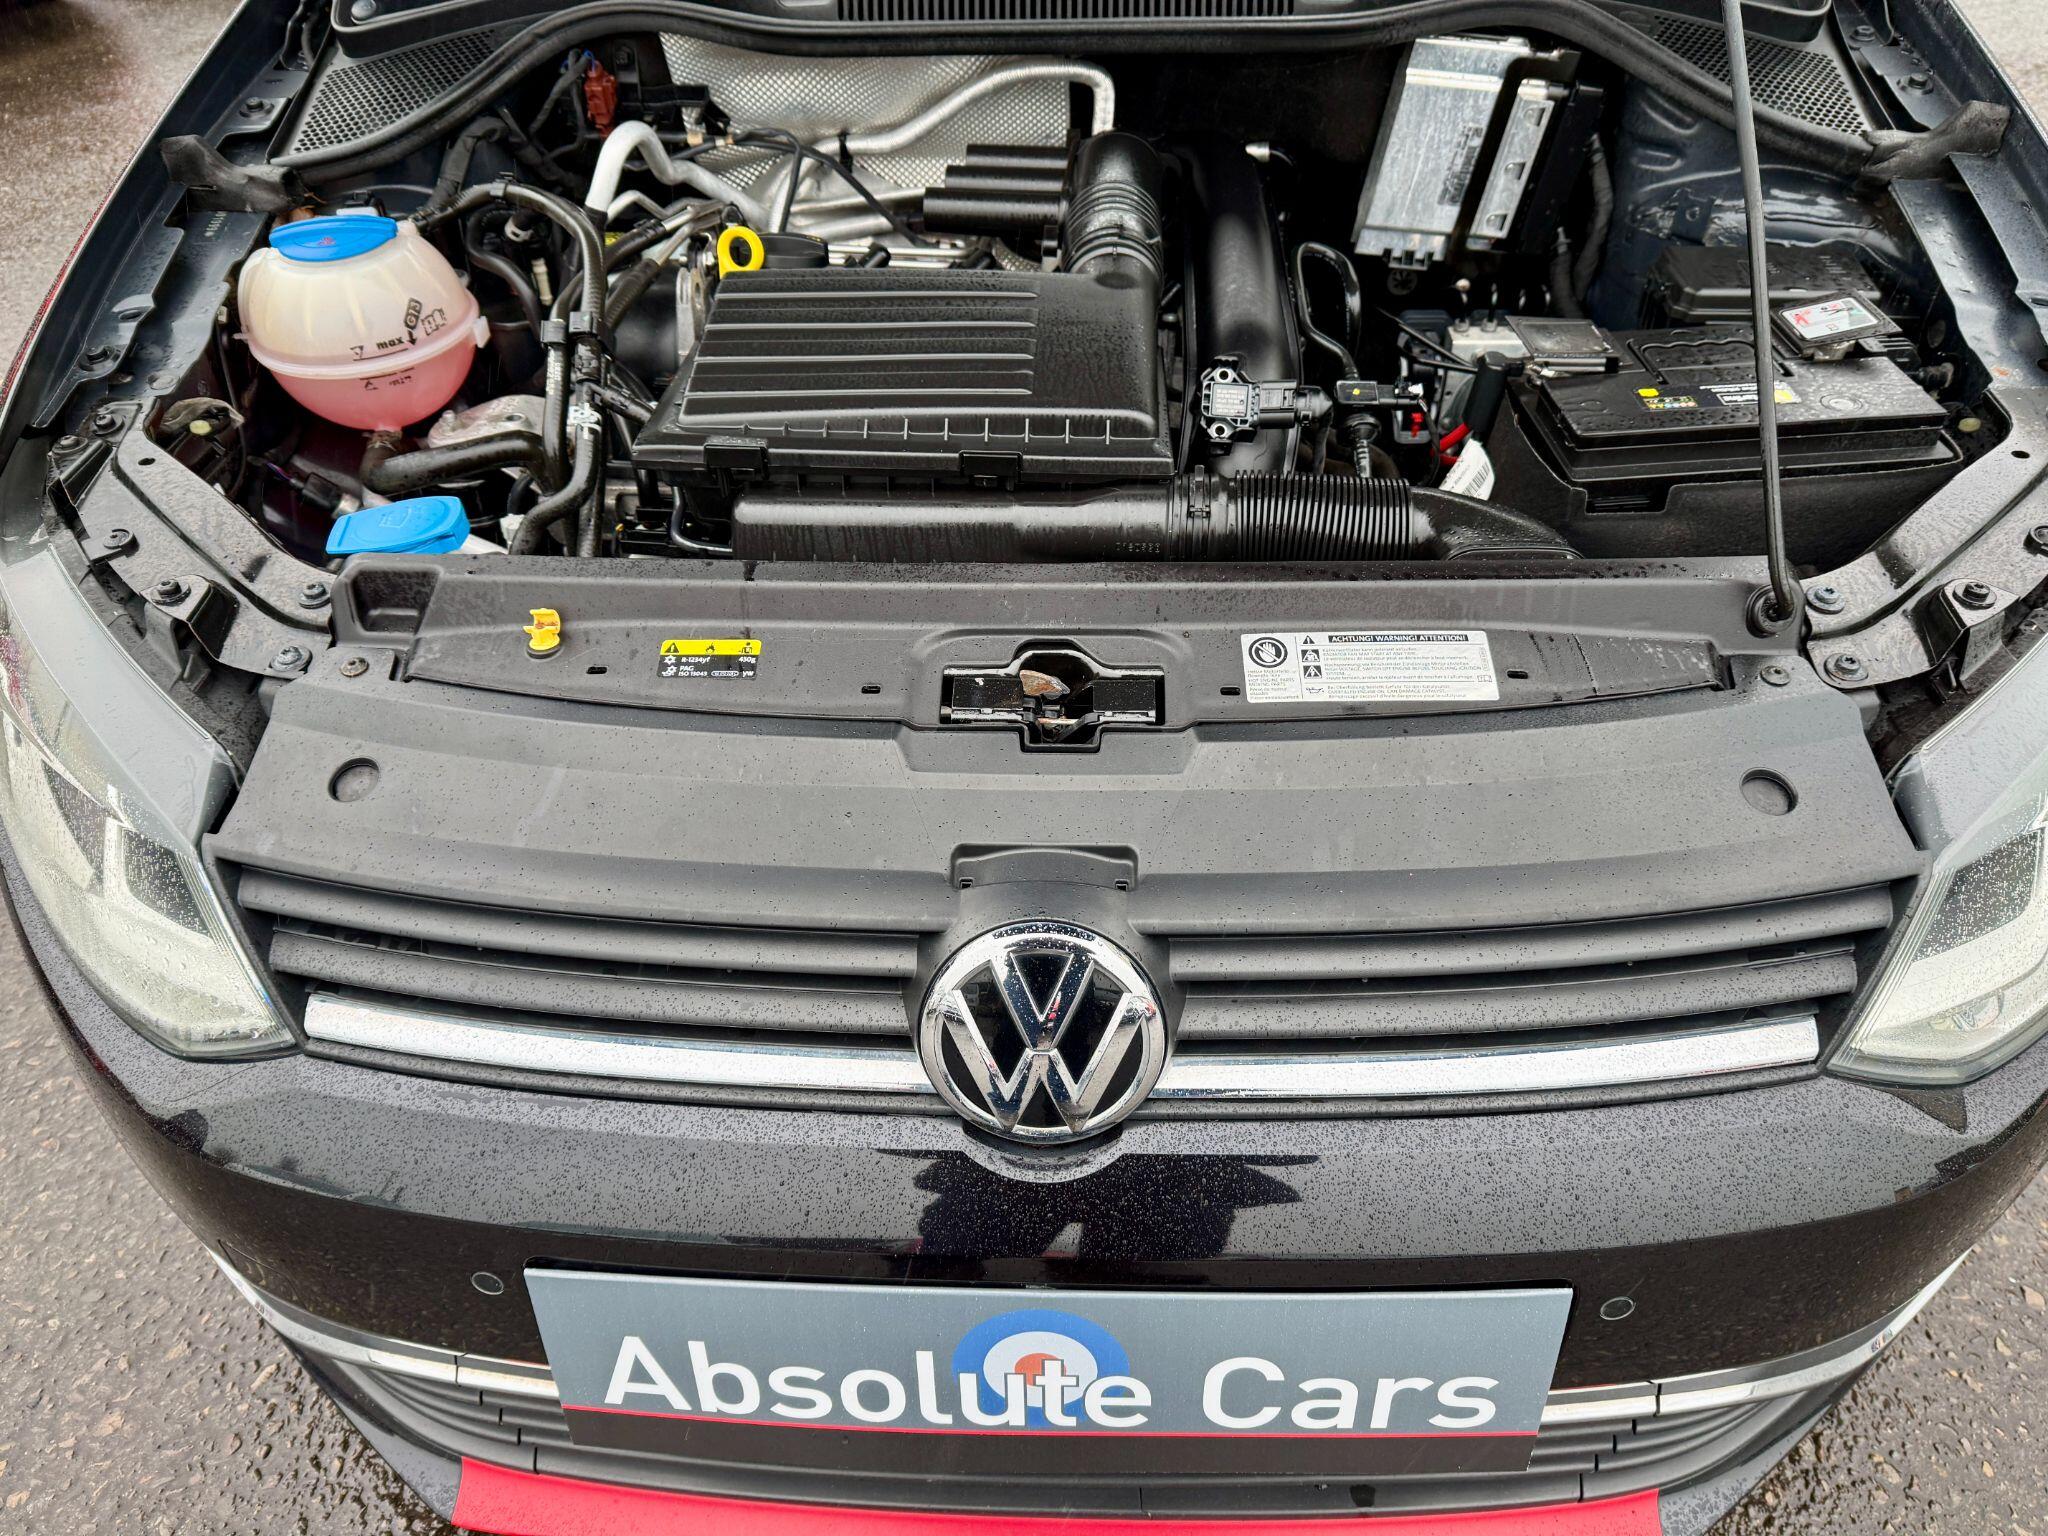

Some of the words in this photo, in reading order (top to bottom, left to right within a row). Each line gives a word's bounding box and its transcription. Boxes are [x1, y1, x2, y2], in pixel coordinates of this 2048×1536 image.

[376, 337, 404, 350] max
[1419, 634, 1467, 642] ATTENTION!
[681, 656, 711, 664] R-1234yf
[604, 1336, 1152, 1428] Absolute
[1202, 1356, 1500, 1430] Cars
